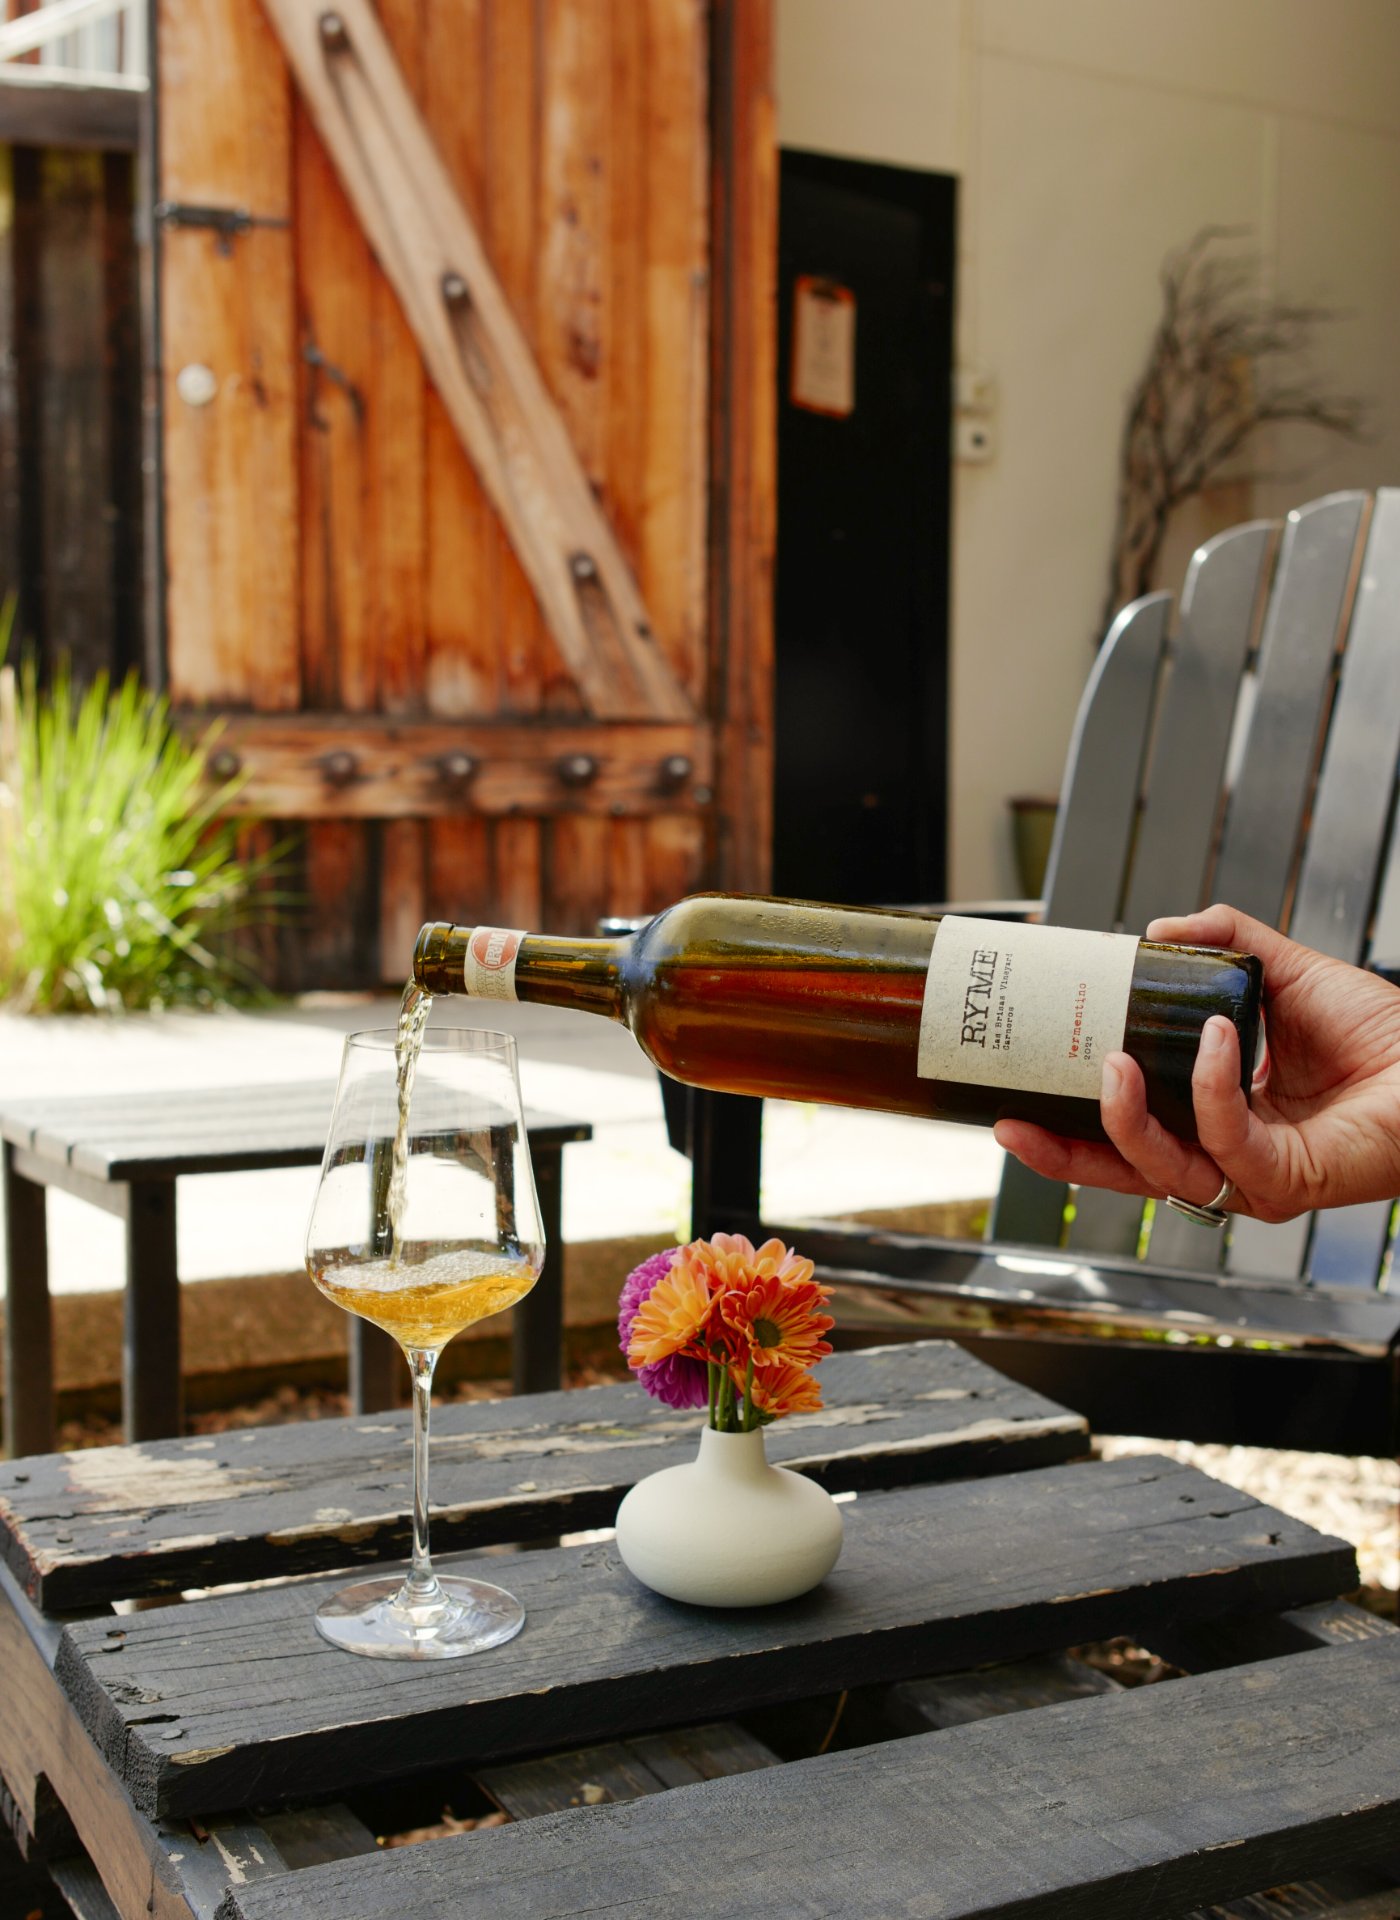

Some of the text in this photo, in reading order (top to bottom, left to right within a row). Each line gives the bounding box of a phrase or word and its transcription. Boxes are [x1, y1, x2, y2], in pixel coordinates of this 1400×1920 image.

[960, 950, 998, 1048] RYME
[995, 995, 1005, 1028] Brisas
[1068, 982, 1087, 1059] Vermentino
[992, 1033, 1001, 1050] Las
[1084, 1036, 1093, 1060] 2022
